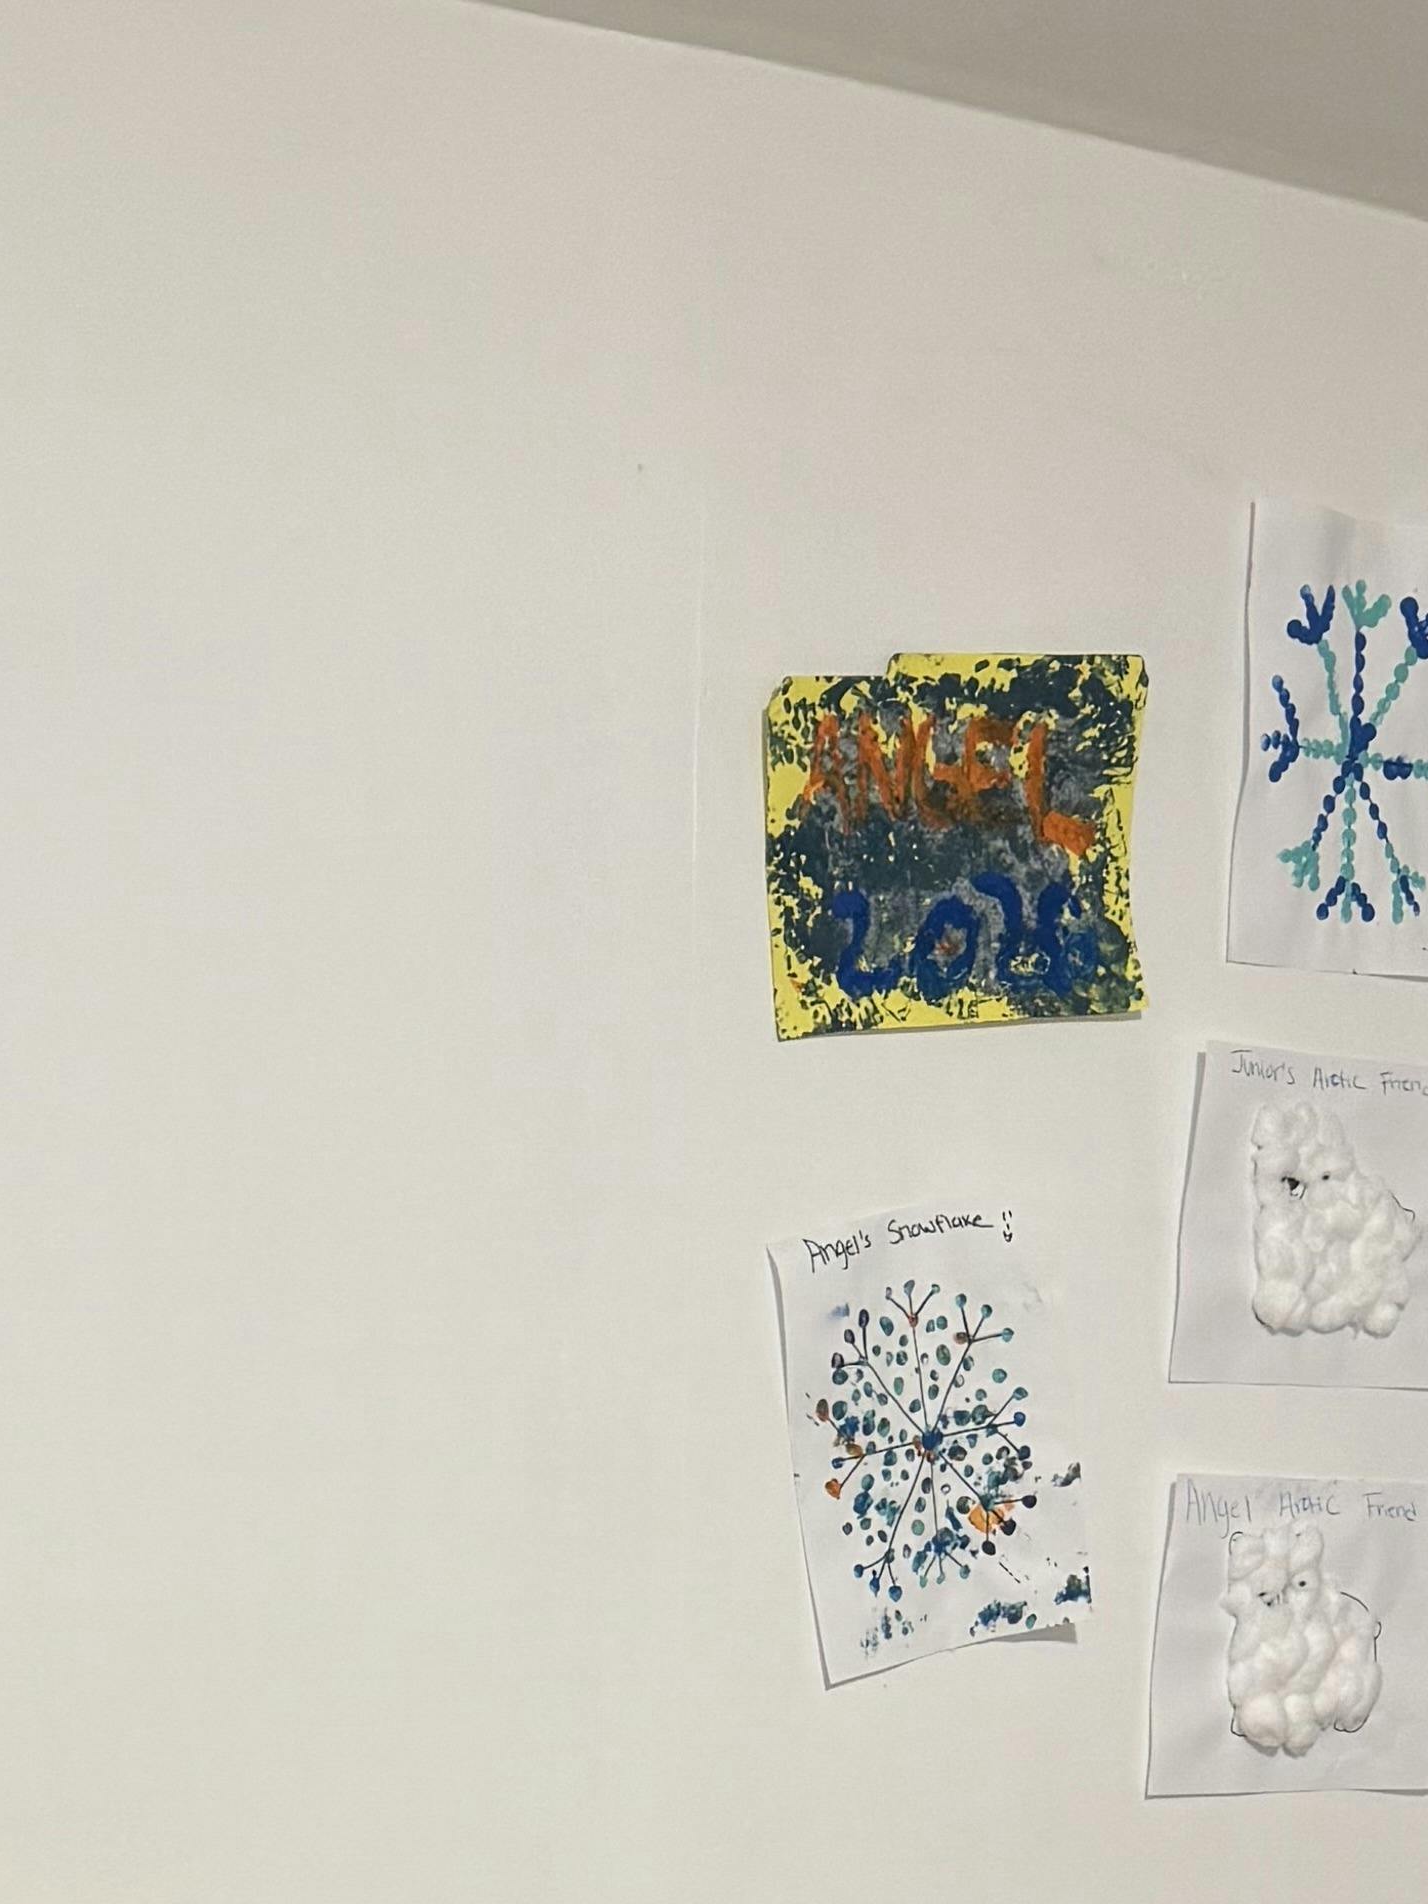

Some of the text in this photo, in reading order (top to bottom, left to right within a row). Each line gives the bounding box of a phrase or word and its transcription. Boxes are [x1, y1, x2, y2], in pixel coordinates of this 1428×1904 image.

[1231, 1049, 1295, 1085] Junior's
[802, 1213, 994, 1273] Angel's Snowflake
